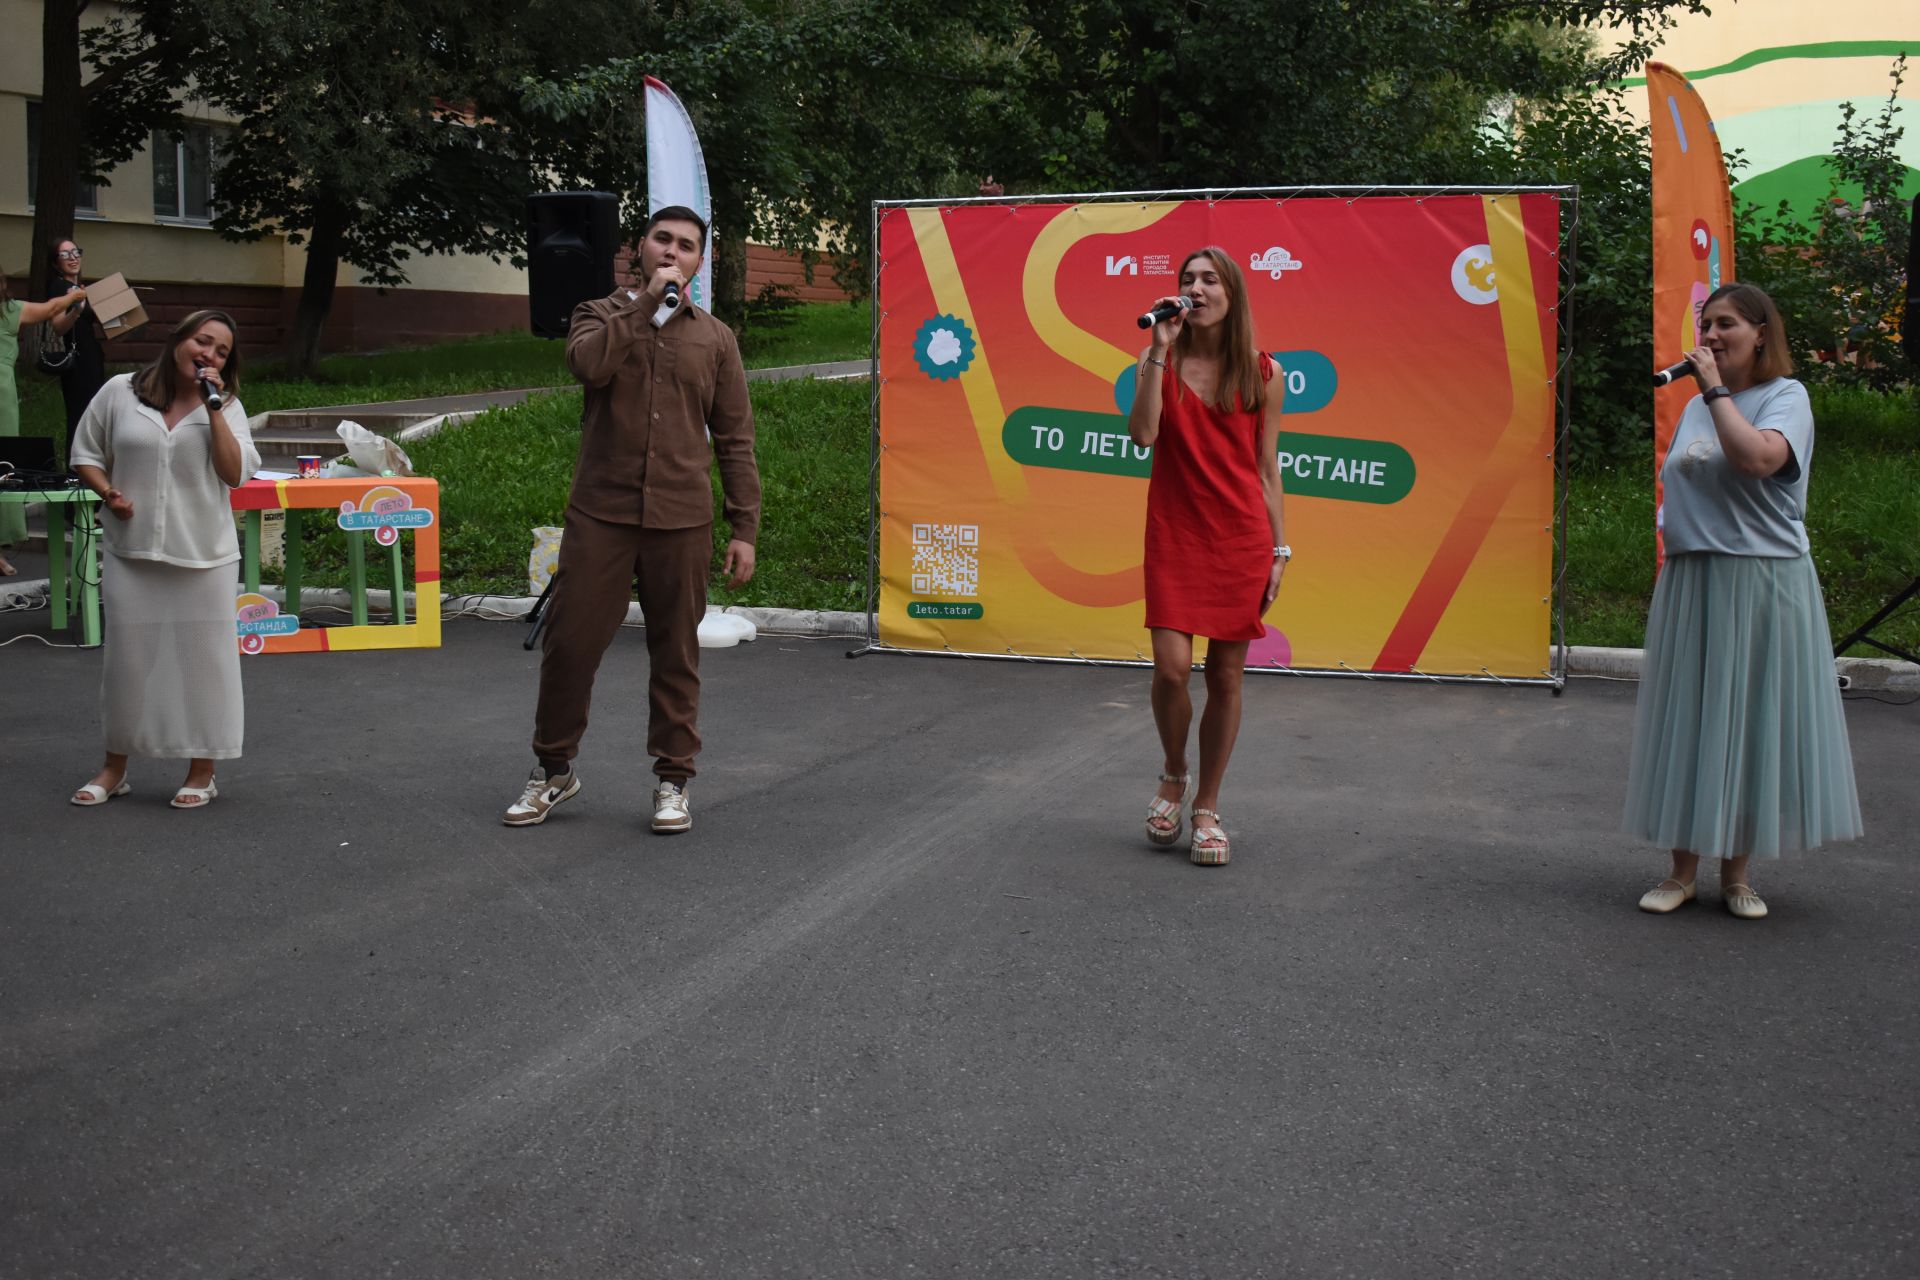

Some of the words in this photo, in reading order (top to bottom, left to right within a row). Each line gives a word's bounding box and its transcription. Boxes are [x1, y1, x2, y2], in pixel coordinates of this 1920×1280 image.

[1031, 425, 1064, 451] ТО
[1277, 451, 1387, 487] РСТАНЕ
[380, 499, 404, 512] ЛЕТО
[347, 514, 354, 525] В
[361, 513, 424, 524] ТАТАРСТАНЕ
[915, 604, 973, 615] leto.tatar
[237, 620, 288, 633] РСТАНДА
